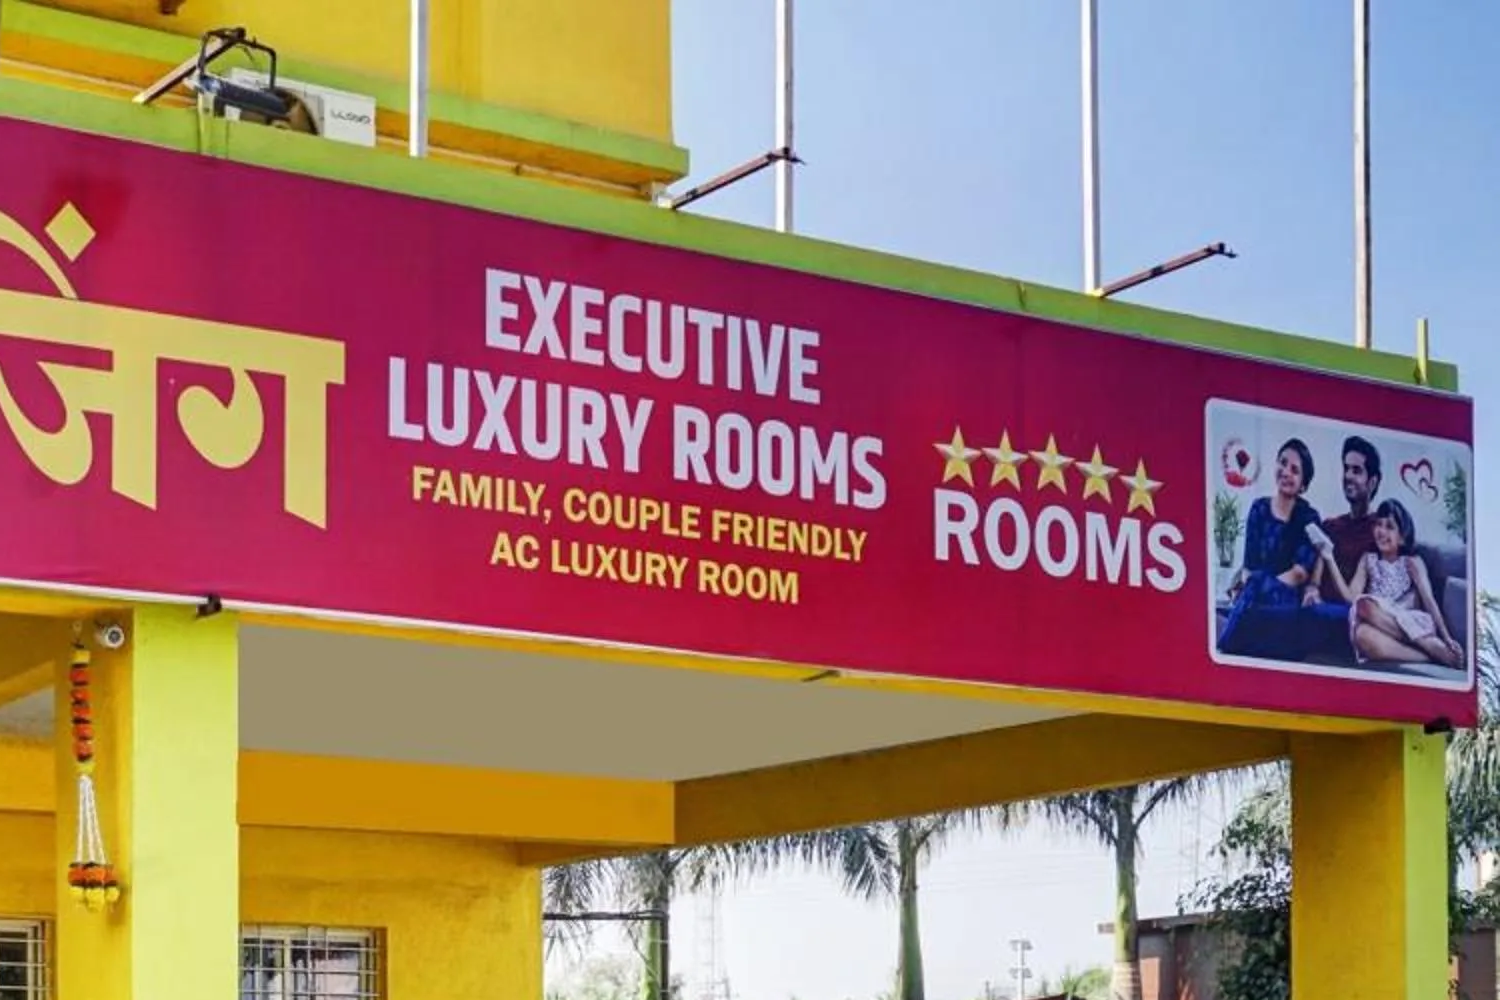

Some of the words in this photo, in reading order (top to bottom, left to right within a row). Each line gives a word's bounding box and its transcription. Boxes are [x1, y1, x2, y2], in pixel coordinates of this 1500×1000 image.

[484, 267, 821, 405] EXECUTIVE
[387, 357, 654, 475] LUXURY
[672, 406, 887, 511] ROOMS
[411, 466, 553, 524] FAMILY,
[564, 487, 702, 540] COUPLE
[711, 509, 868, 563] FRIENDLY
[490, 530, 541, 569] AC
[551, 543, 689, 593] LUXURY
[698, 564, 799, 604] ROOM
[932, 487, 1188, 593] ROOMS
